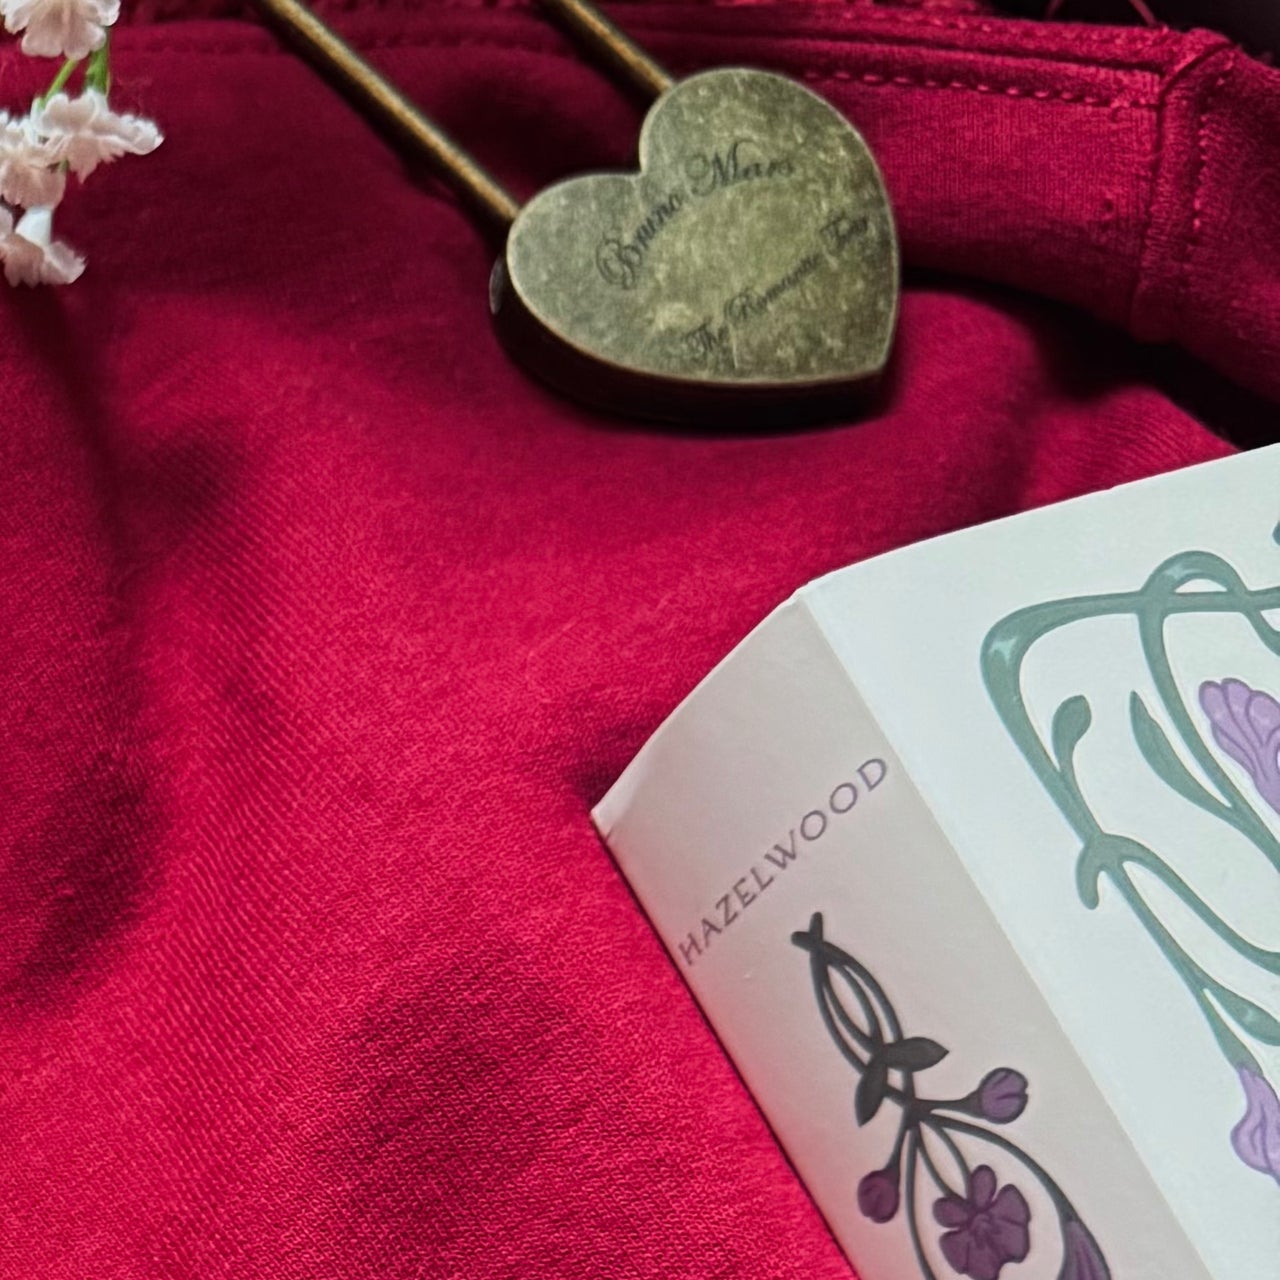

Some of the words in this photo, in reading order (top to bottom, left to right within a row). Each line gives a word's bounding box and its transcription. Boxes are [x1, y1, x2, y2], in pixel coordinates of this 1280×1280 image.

[596, 192, 684, 290] Bruno
[685, 137, 795, 196] Mars
[677, 757, 888, 966] HAZELWOOD
